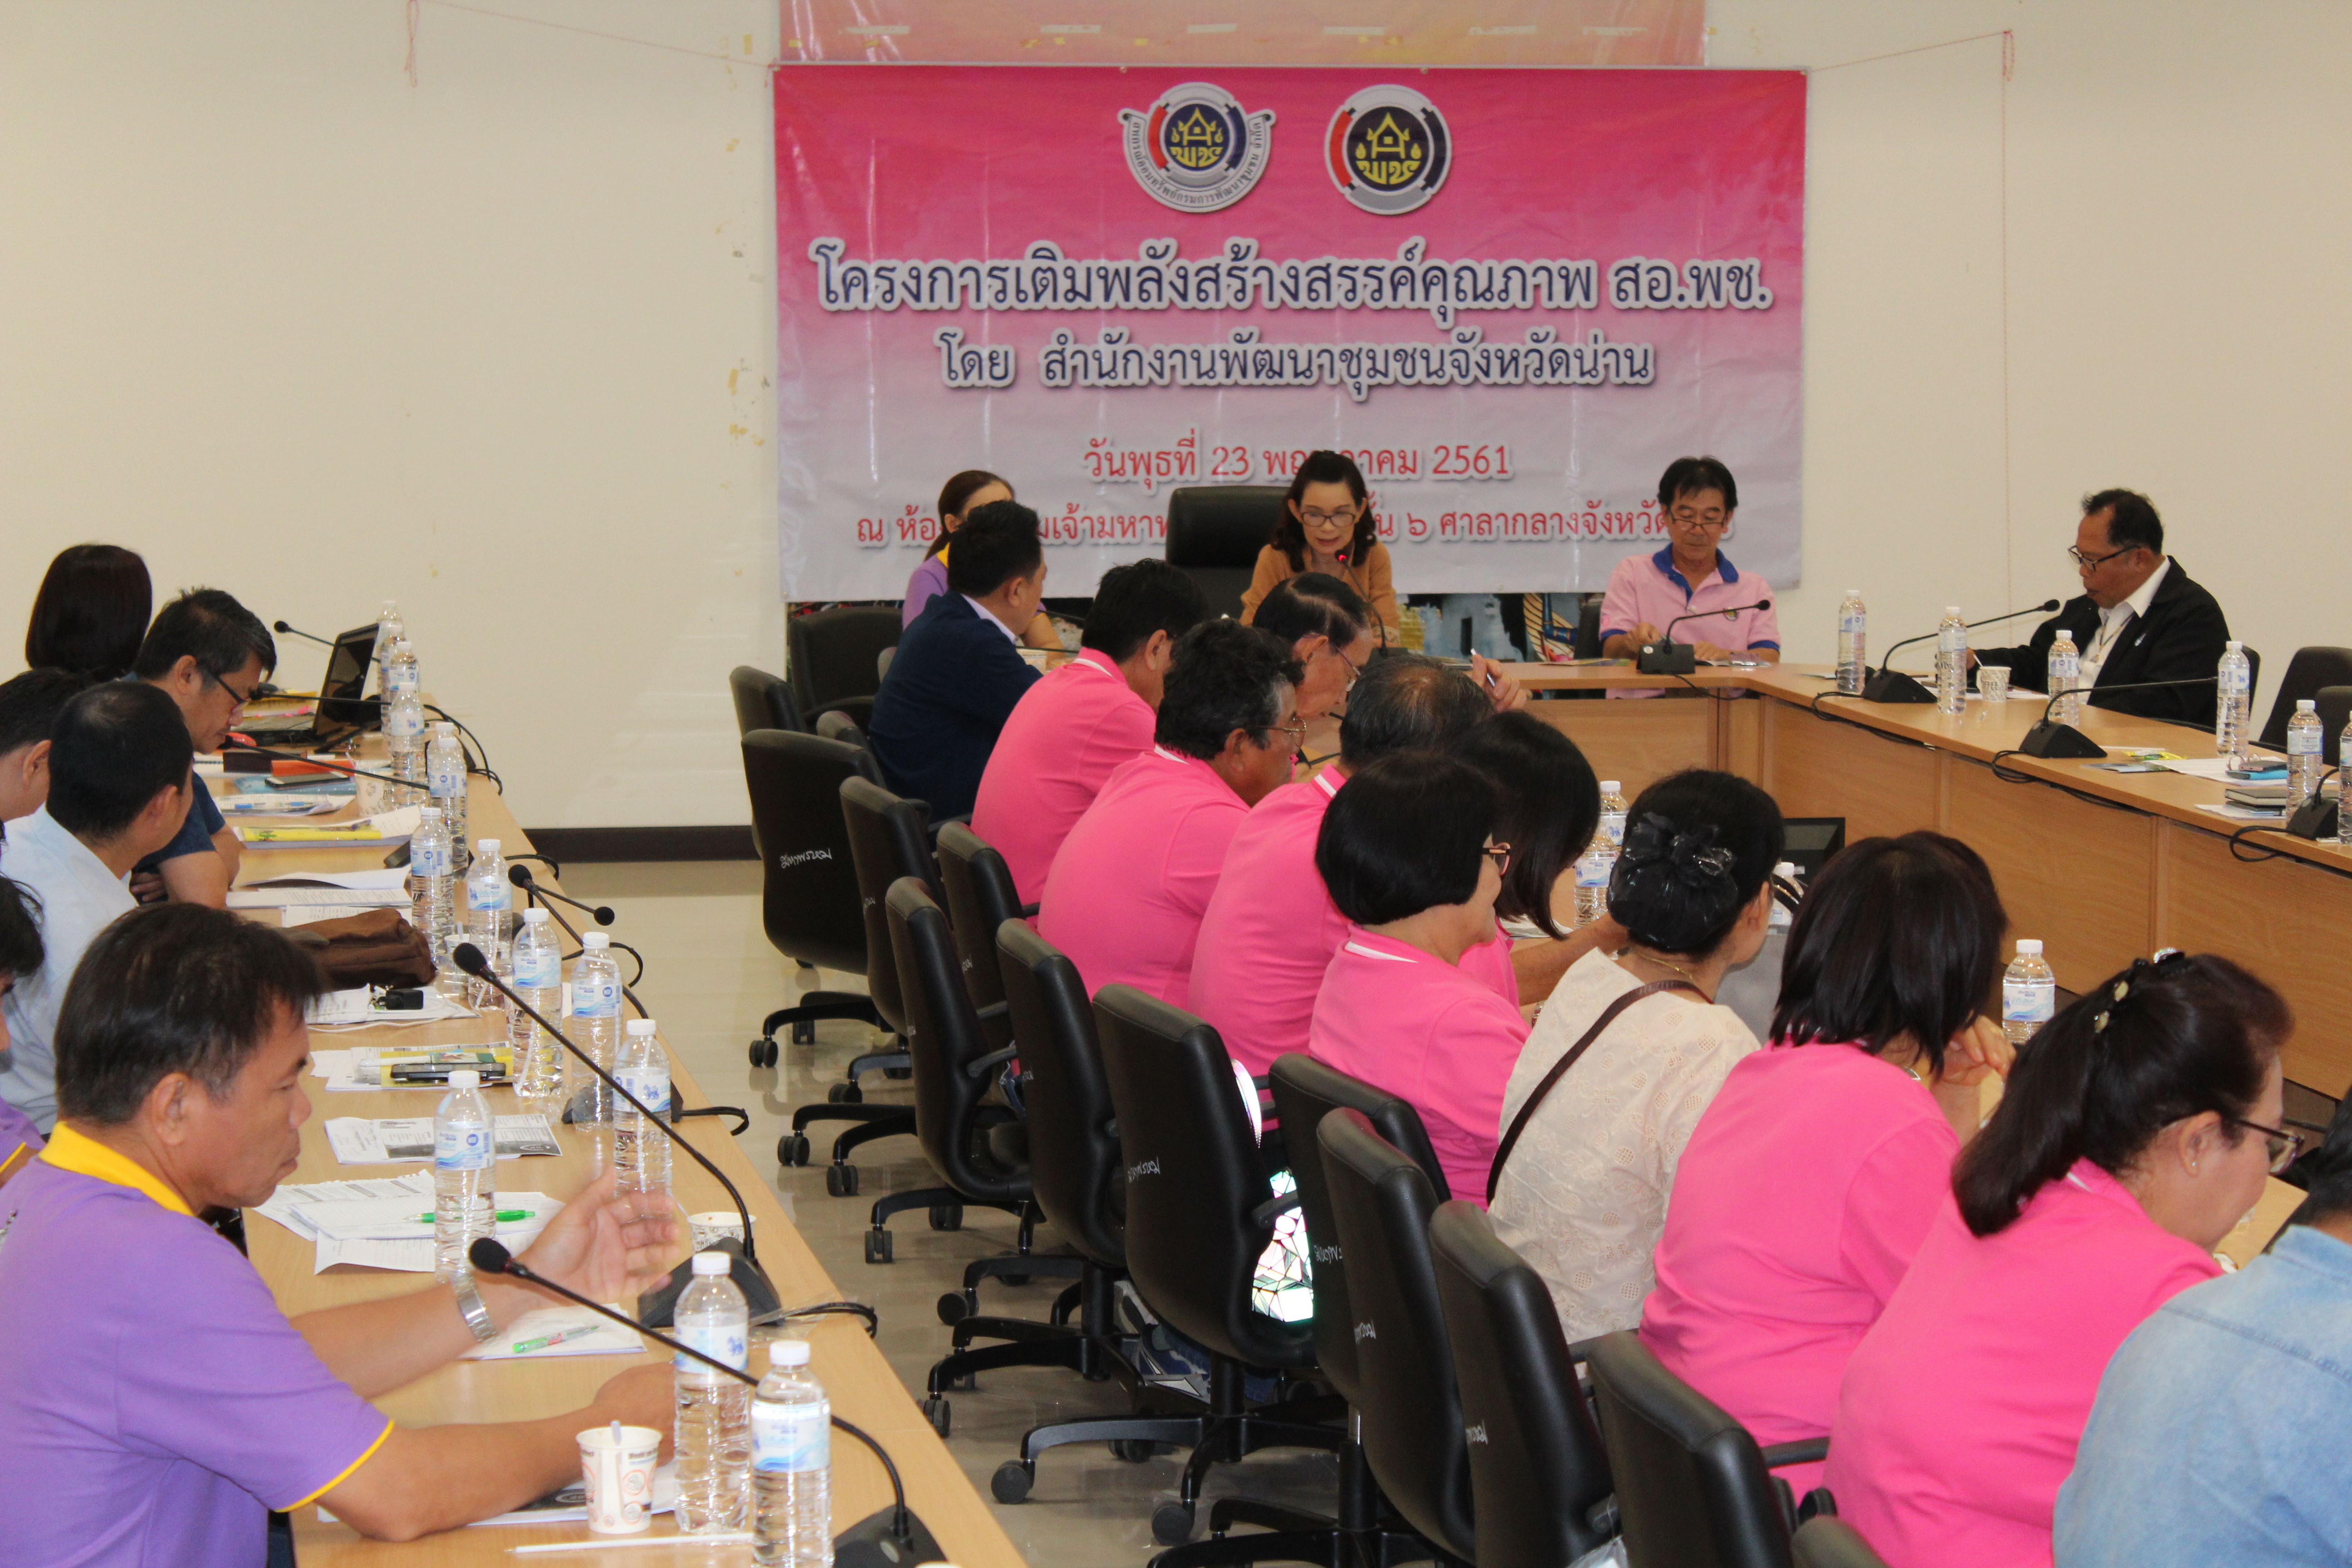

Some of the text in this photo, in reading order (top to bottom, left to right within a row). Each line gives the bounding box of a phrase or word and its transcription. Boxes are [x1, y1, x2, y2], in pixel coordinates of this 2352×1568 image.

[814, 242, 1768, 323] โครงการเติมพลังสร้างสรรค์คุณภาพ สอ.พช.
[939, 329, 1651, 397] โดย สำนักงานพัฒนาชุมชนจังหวัดน่าน
[1084, 428, 1196, 489] วันพุธที่
[1212, 446, 1249, 475] 23
[1433, 445, 1508, 475] 2561
[858, 519, 882, 542] ณ
[1407, 512, 1427, 537] ๖
